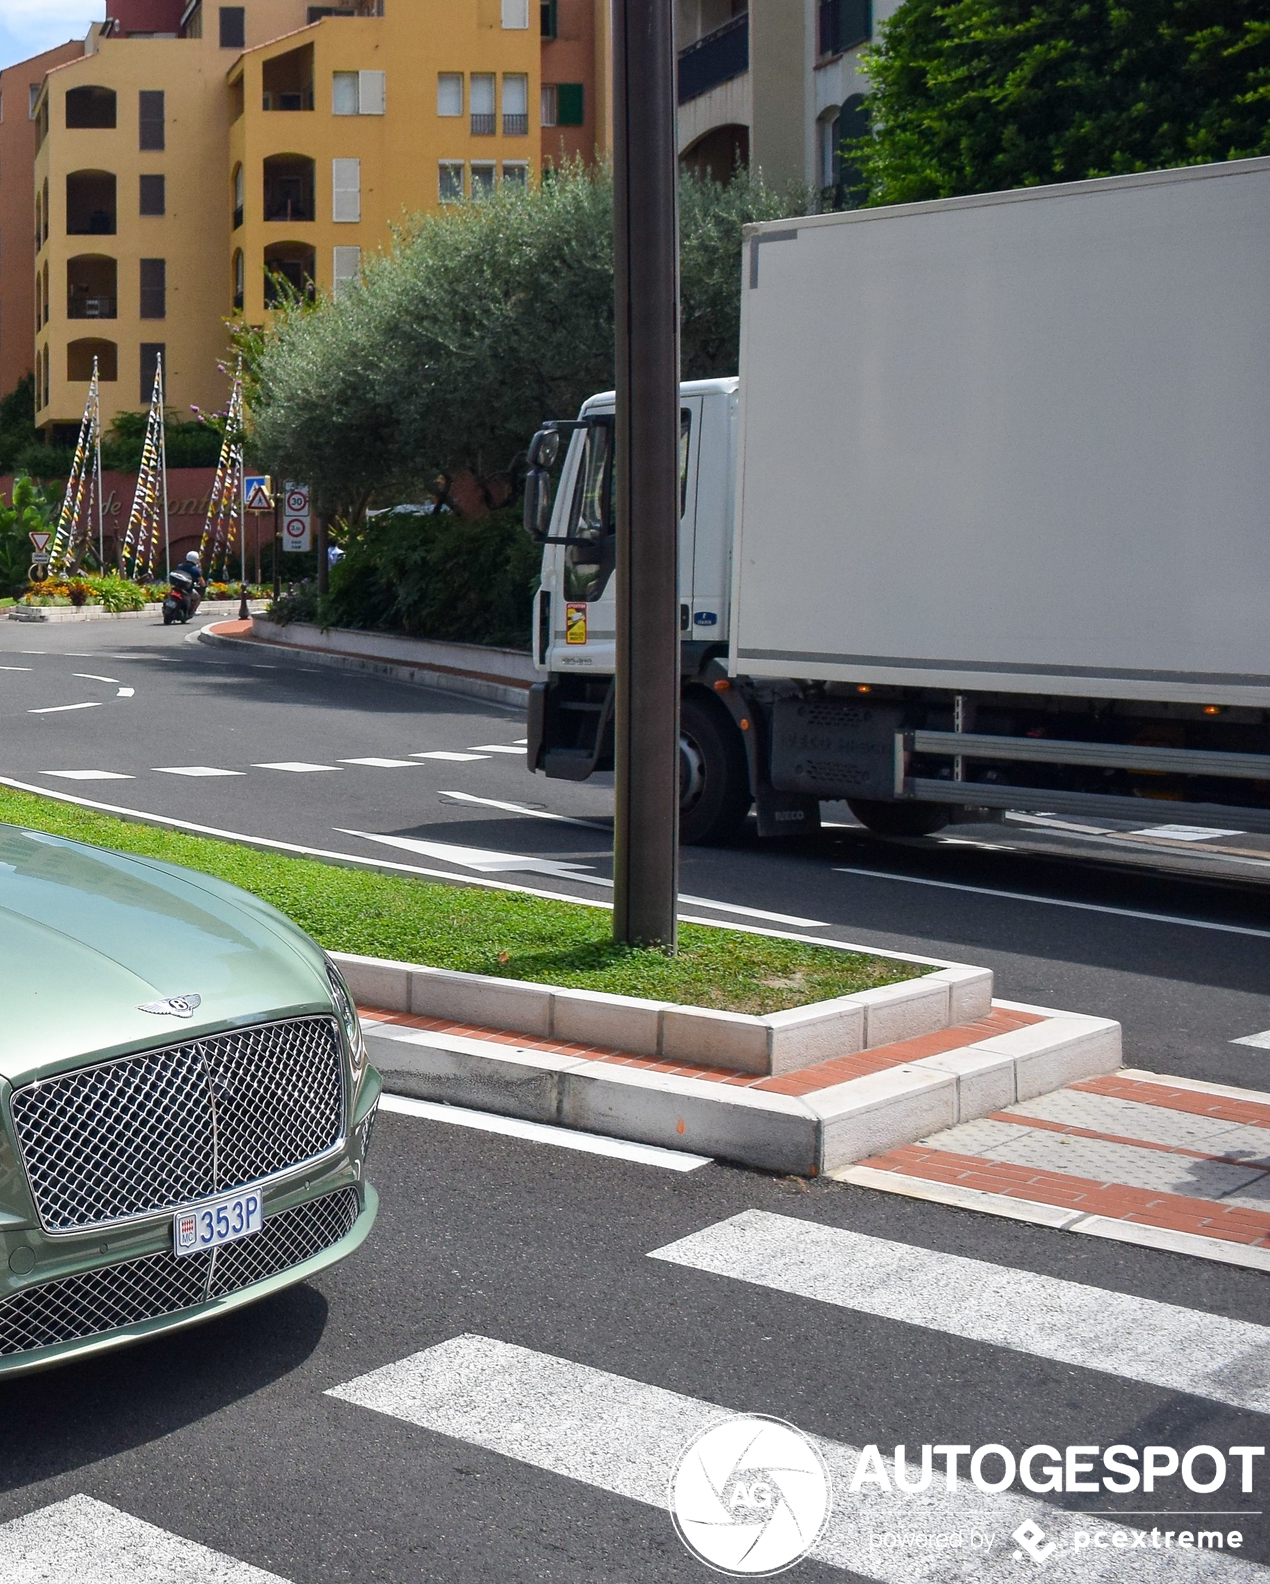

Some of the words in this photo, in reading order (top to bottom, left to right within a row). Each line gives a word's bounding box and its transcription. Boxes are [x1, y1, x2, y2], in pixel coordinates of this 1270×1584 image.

[291, 497, 303, 506] 30
[775, 811, 805, 821] IVECO
[200, 1196, 258, 1244] 353P
[182, 1232, 194, 1244] MC
